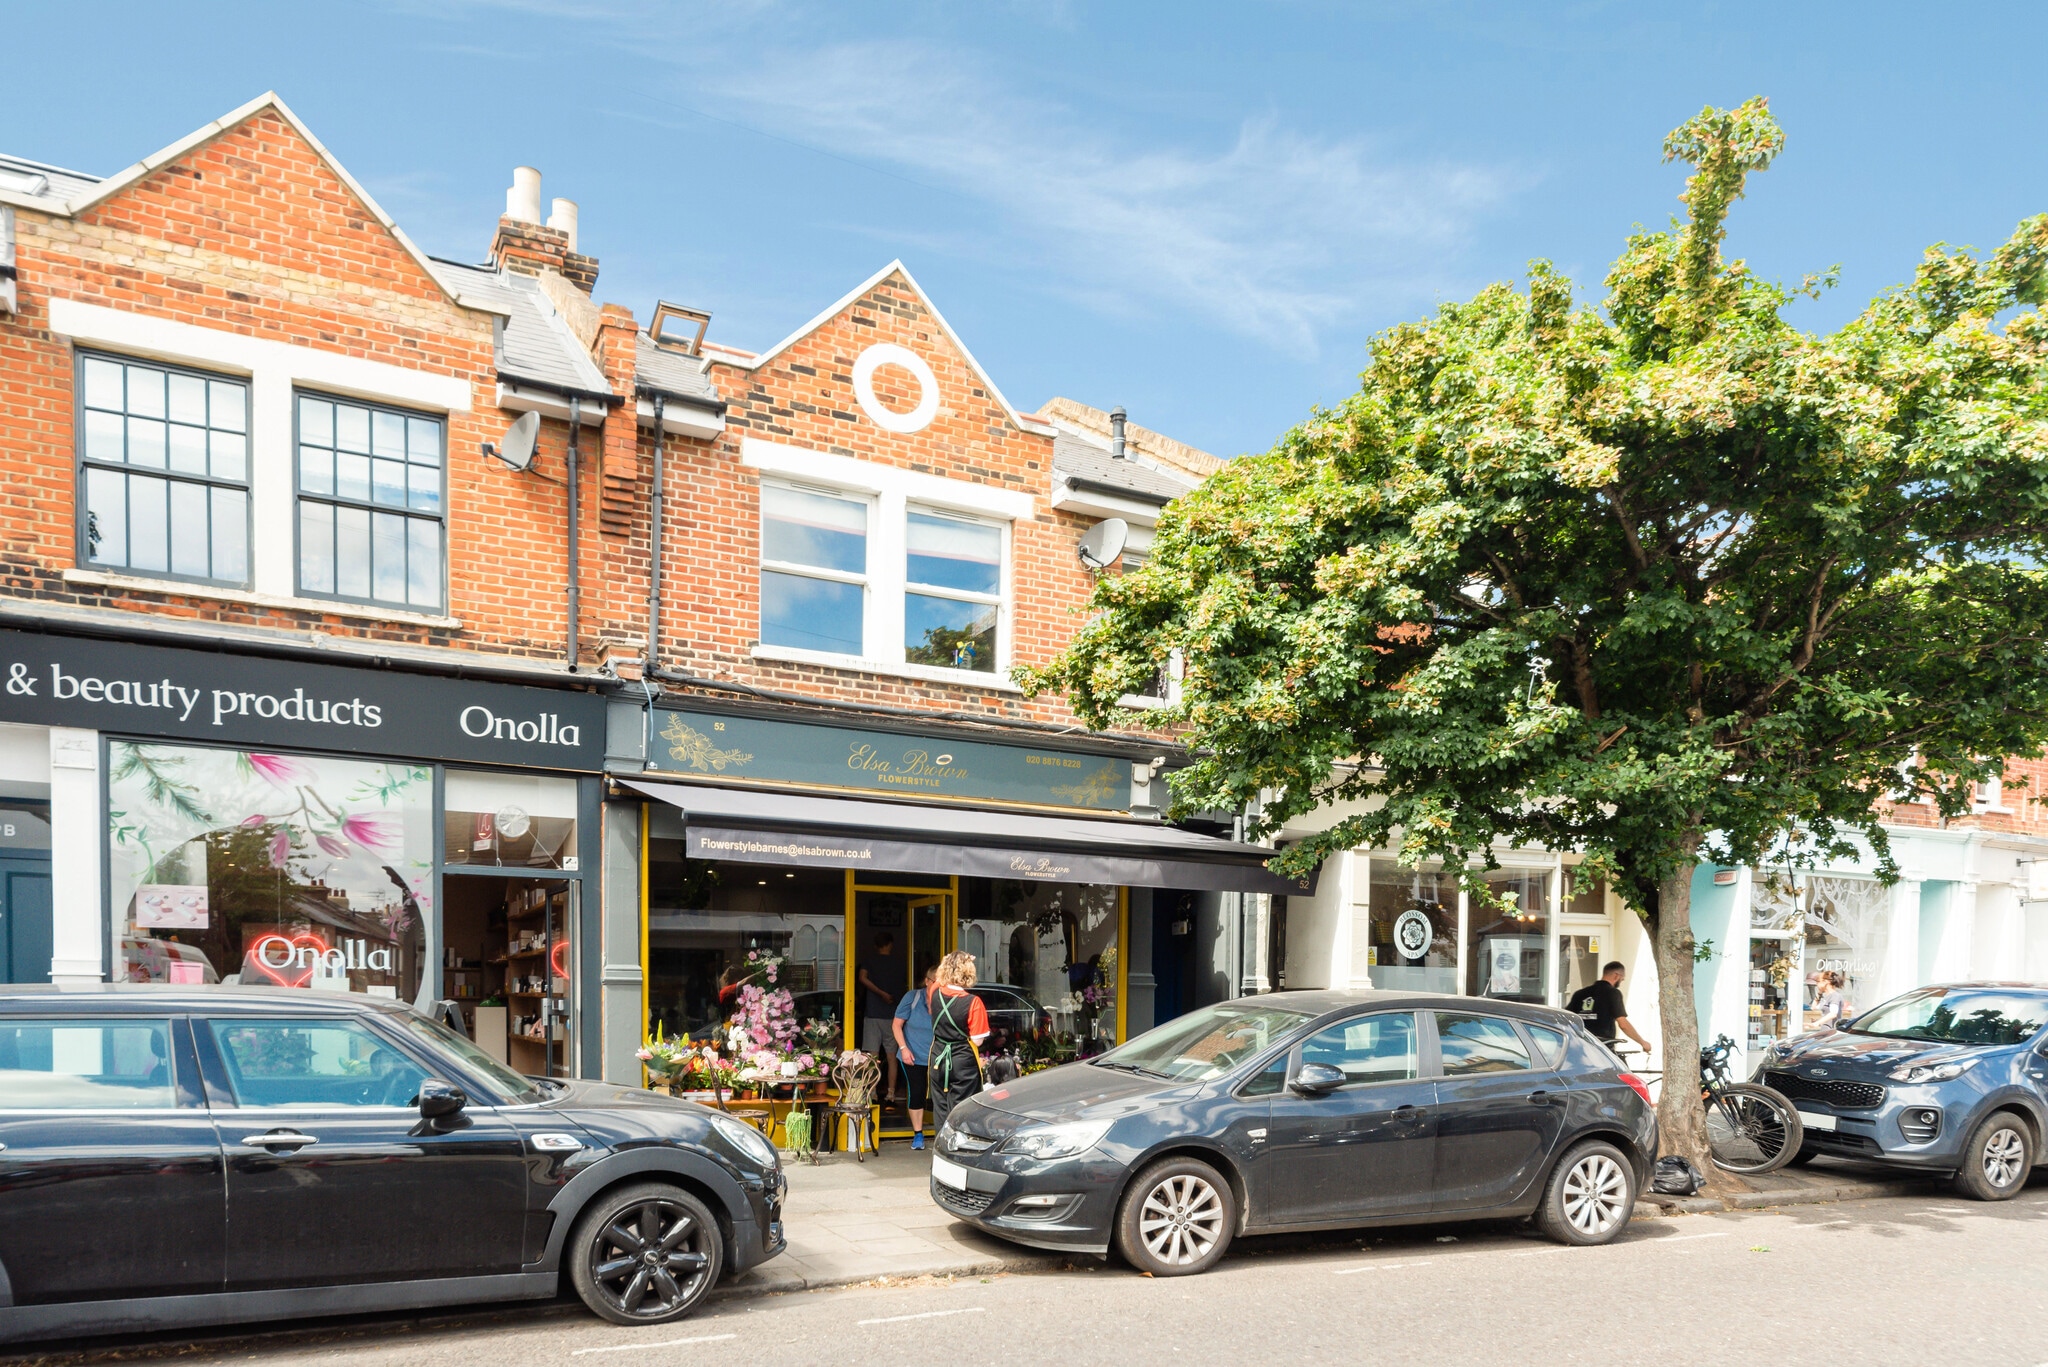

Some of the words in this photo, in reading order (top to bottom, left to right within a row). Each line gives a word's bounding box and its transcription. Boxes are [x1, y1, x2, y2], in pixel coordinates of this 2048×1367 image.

[6, 662, 38, 696] &
[50, 663, 200, 721] beauty
[212, 688, 382, 728] products
[460, 705, 580, 746] Onolla
[714, 722, 725, 731] 52
[848, 741, 892, 770] Elsa
[896, 749, 968, 779] Brown
[1026, 755, 1040, 764] 020
[878, 774, 940, 787] FLOWERSTYLE
[700, 837, 872, 859] Flowerstylebarnes@elsabrown.co.uk
[1010, 856, 1032, 871] Elsa
[1033, 858, 1070, 874] Brown
[1299, 880, 1310, 889] 52
[1399, 911, 1428, 925] BLOSSOM
[258, 937, 391, 970] Onolla
[1816, 958, 1832, 971] Oh
